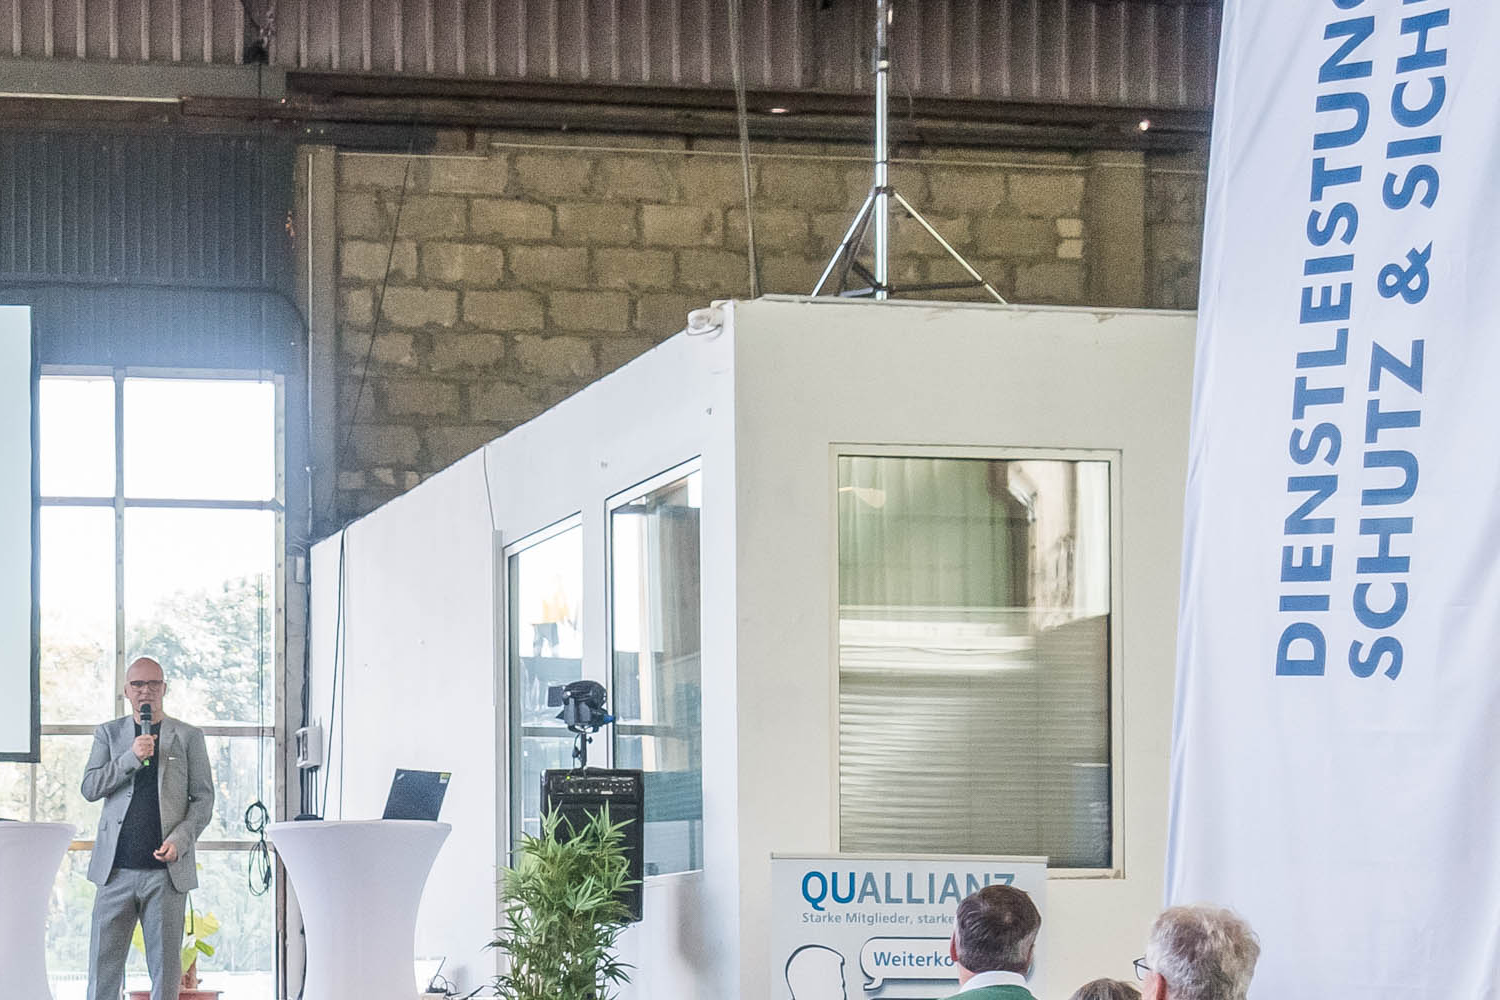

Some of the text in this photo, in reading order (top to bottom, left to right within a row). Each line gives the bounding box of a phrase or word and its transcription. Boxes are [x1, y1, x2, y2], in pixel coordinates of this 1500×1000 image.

[1274, 0, 1375, 679] DIENSTLEISTUN
[1348, 0, 1451, 682] SCHUTZ & SICH
[802, 912, 842, 925] Starke
[845, 912, 914, 928] Mitglieder,
